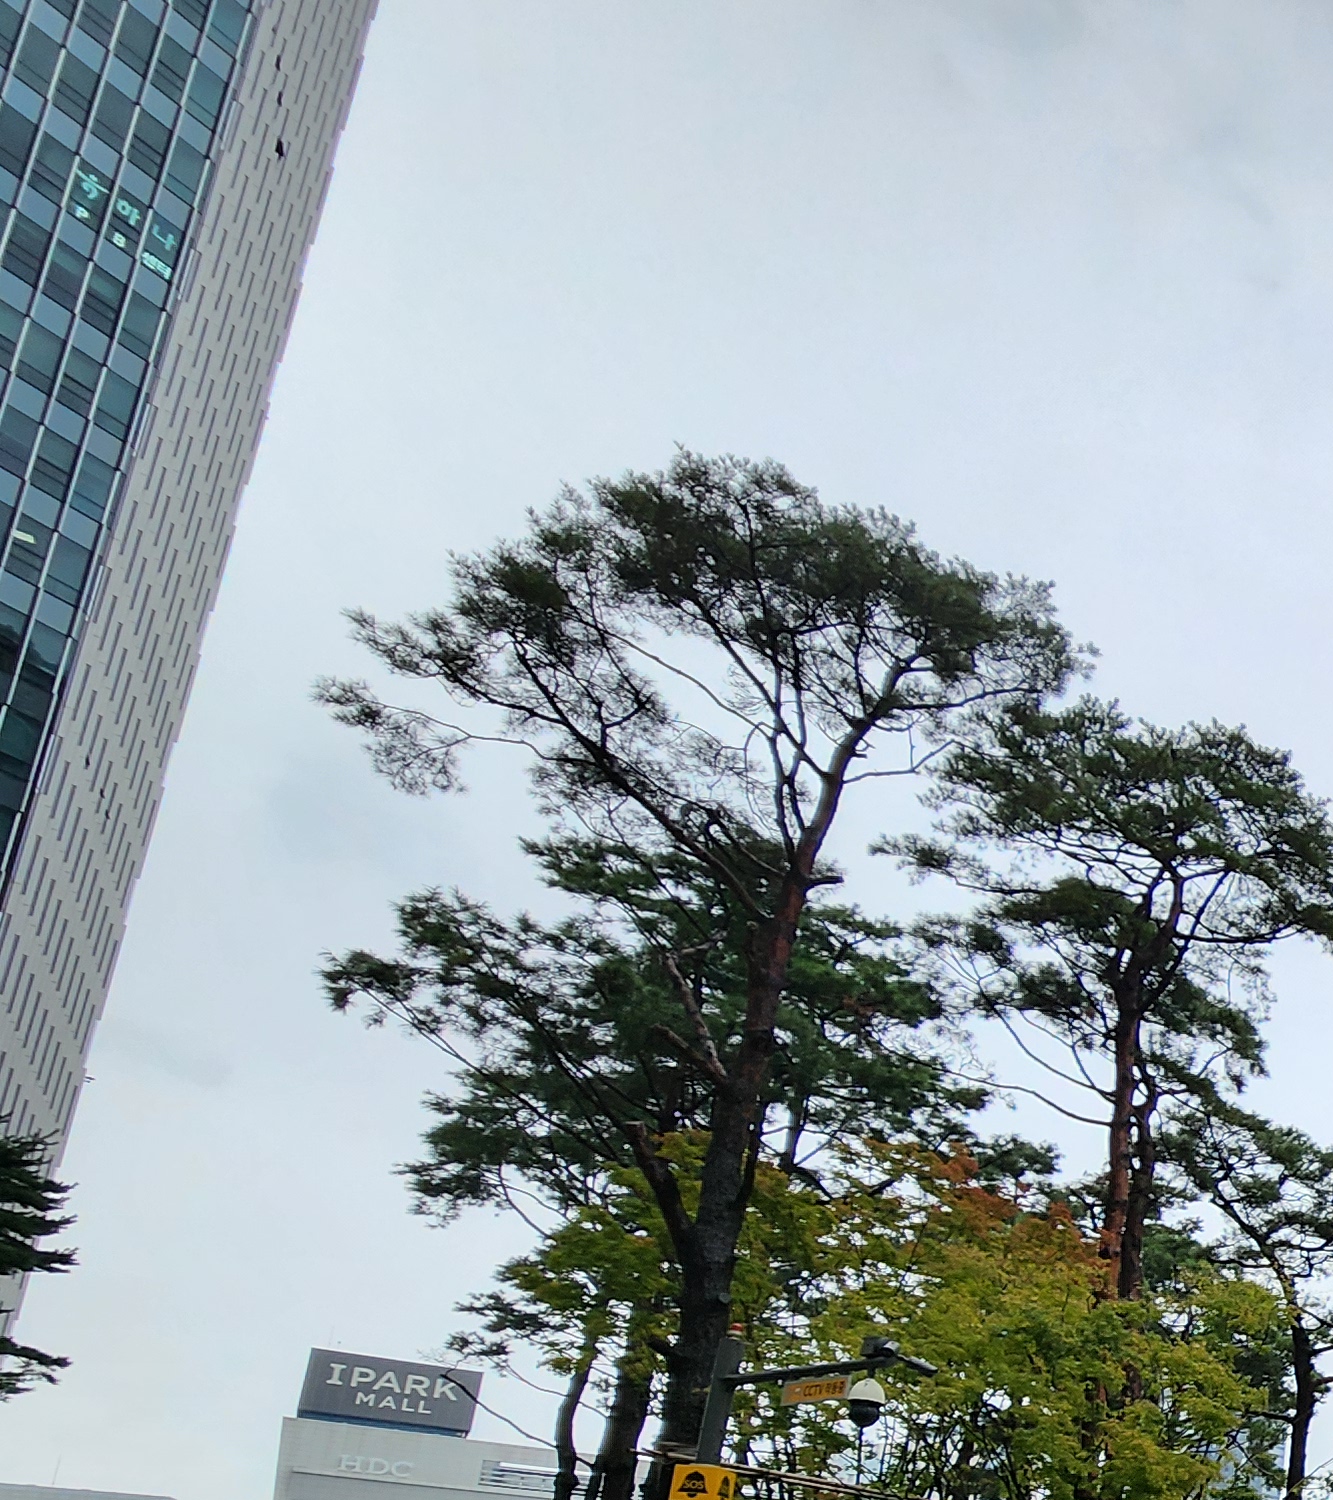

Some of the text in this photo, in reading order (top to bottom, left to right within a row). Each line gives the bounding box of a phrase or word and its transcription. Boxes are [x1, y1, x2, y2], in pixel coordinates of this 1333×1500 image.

[325, 1363, 459, 1401] IPARK
[803, 1384, 824, 1398] CCTV
[355, 1392, 432, 1415] MALL
[337, 1454, 415, 1478] HDC
[683, 1480, 704, 1490] SOS
